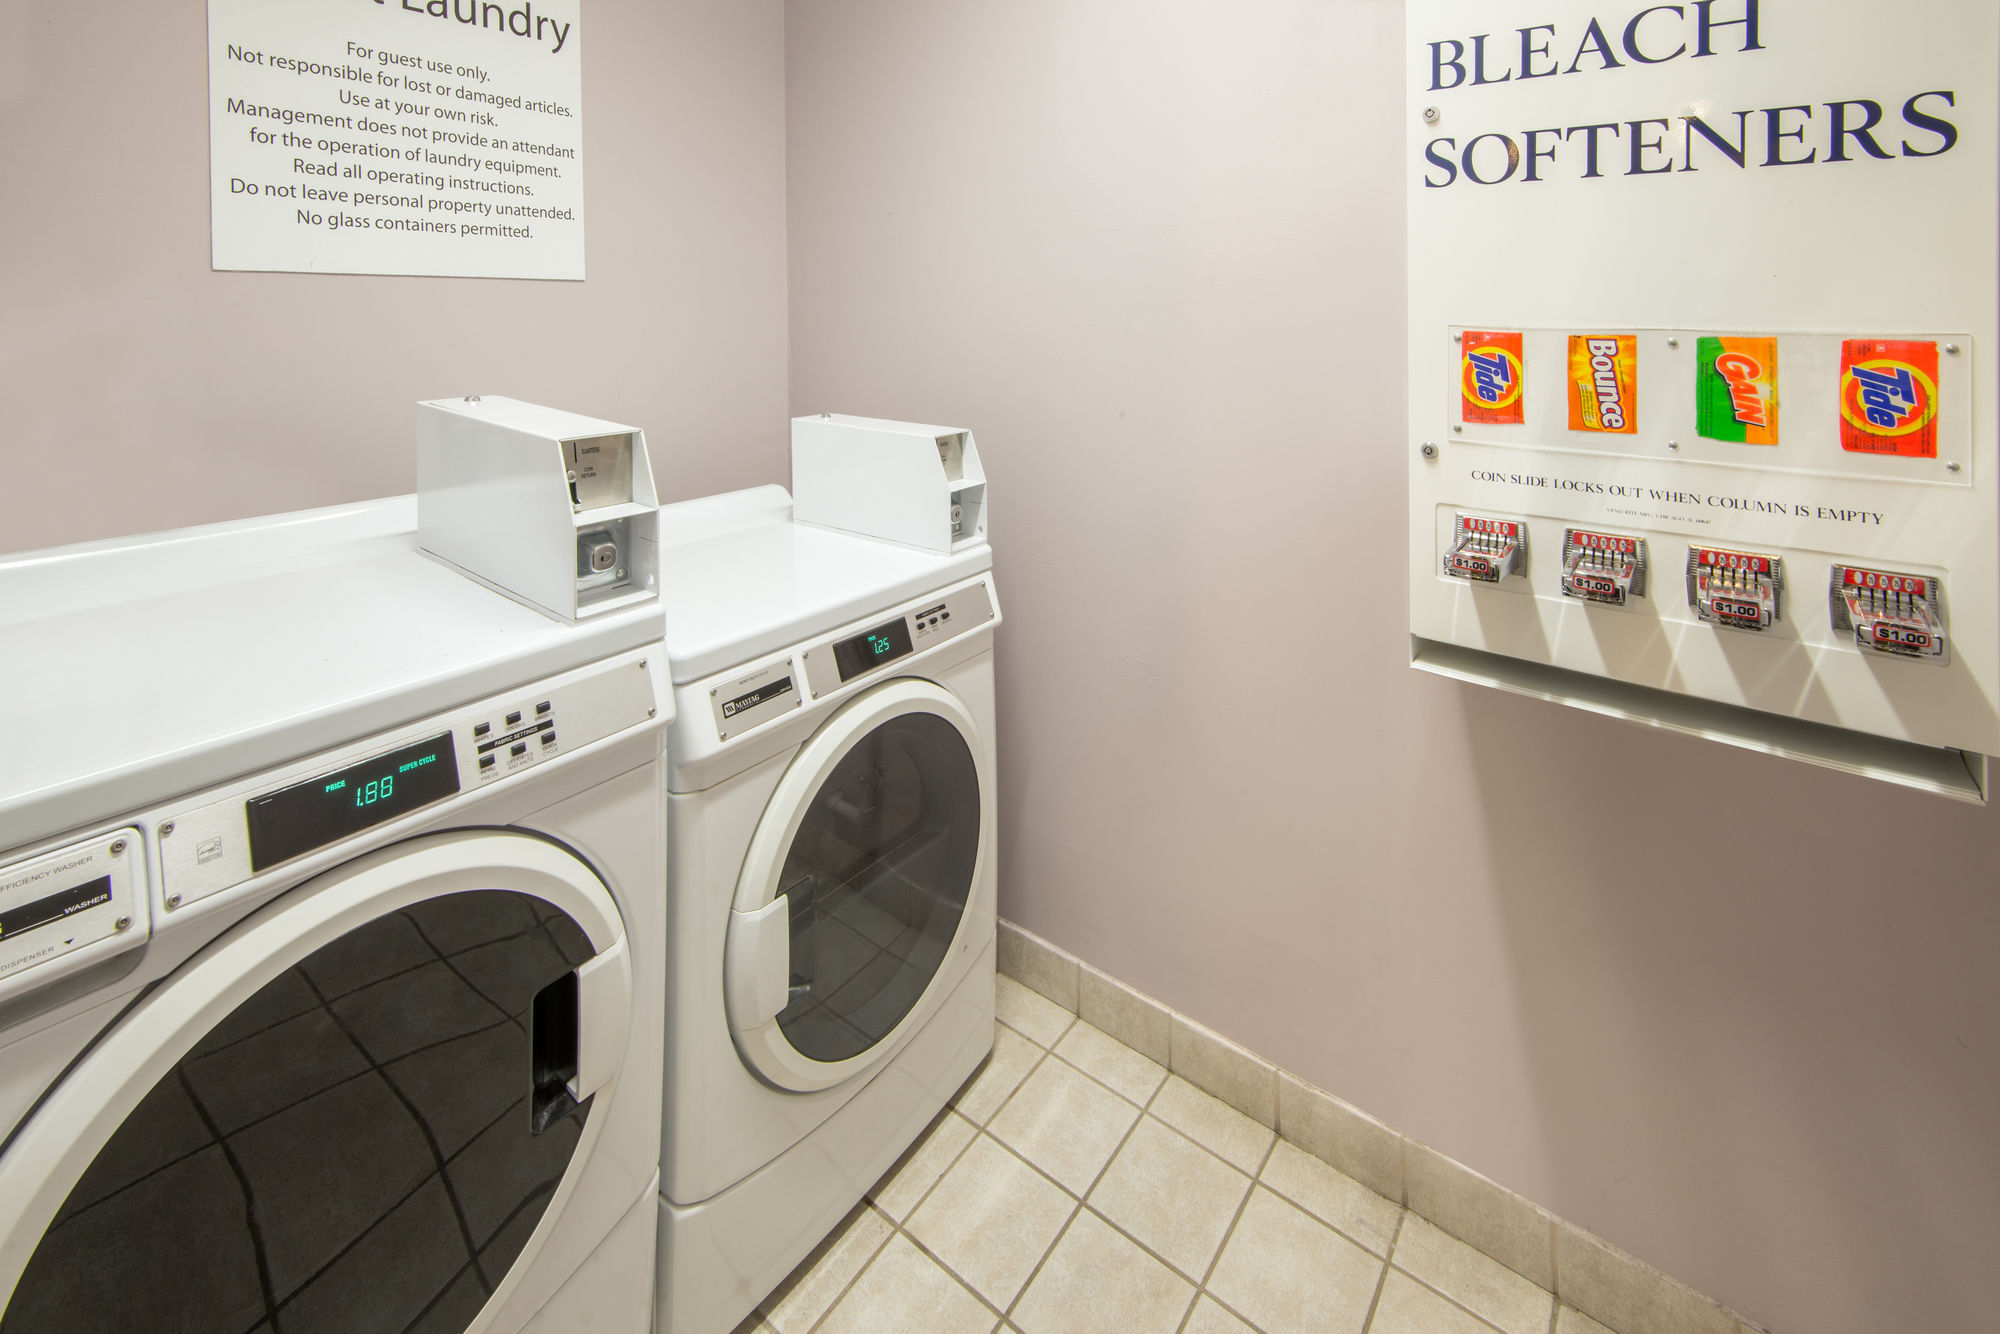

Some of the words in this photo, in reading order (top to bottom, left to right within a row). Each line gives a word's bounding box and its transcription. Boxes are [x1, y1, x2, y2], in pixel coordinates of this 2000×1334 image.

[347, 41, 373, 59] For
[378, 51, 422, 69] guest
[427, 60, 452, 74] use
[456, 66, 490, 83] only.
[1426, 0, 1766, 91] BLEACH
[228, 44, 263, 65] Not
[270, 55, 373, 83] responsible
[377, 71, 399, 87] for
[404, 76, 432, 94] lost
[436, 85, 451, 96] or
[455, 86, 521, 108] damaged
[525, 100, 573, 117] articles.
[339, 89, 370, 107] Use
[374, 98, 390, 110] at
[394, 101, 430, 116] your
[434, 108, 466, 122] own
[470, 112, 498, 127] risk.
[227, 97, 352, 129] Management
[357, 117, 396, 135] does
[402, 126, 428, 139] not
[432, 129, 488, 147] provide
[492, 139, 508, 150] an
[512, 141, 575, 158] attendant
[1424, 90, 1960, 189] SOFTENERS
[250, 126, 277, 144] for
[282, 132, 312, 148] the
[317, 139, 400, 159] operation
[405, 148, 421, 161] of
[425, 149, 481, 171] laundry
[484, 159, 561, 178] equipment.
[293, 158, 337, 176] Read
[343, 164, 361, 179] all
[367, 170, 444, 190] operating
[449, 175, 534, 196] instructions.
[230, 178, 258, 195] Do
[265, 184, 296, 198] not
[302, 184, 348, 202] leave
[353, 192, 423, 208] personal
[428, 199, 492, 216] property
[495, 205, 575, 220] unattended.
[297, 209, 322, 225] No
[328, 212, 370, 229] glass
[374, 218, 456, 233] containers
[461, 223, 533, 239] permitted.
[1467, 351, 1511, 403] Tide
[1586, 338, 1625, 429] Bounce
[1715, 352, 1766, 427] GAIN
[1850, 364, 1918, 429] Tide
[1471, 470, 1506, 483] COIN
[1510, 474, 1548, 488] SLIDE
[1554, 478, 1604, 494] LOCKS
[1609, 485, 1643, 498] OUT
[1649, 489, 1701, 505] WHEN
[1707, 495, 1787, 514] COLUMN
[1795, 504, 1810, 517] IS
[1817, 507, 1885, 525] EMPTY
[1456, 558, 1487, 571] $1.00
[1576, 578, 1611, 592] $1.00
[1715, 602, 1756, 617] $1.00
[1879, 628, 1927, 645] $1.00
[735, 694, 760, 709] MAYTAG
[494, 736, 513, 747] FABRIC
[513, 726, 538, 740] SETTINGS
[399, 761, 418, 773] SUPER
[418, 754, 436, 766] CYCLE
[325, 780, 346, 793] PRICE
[356, 775, 393, 807] 1.88
[54, 855, 94, 874] WASHER
[64, 893, 108, 915] WASHER
[1, 946, 54, 972] DISPENSER
